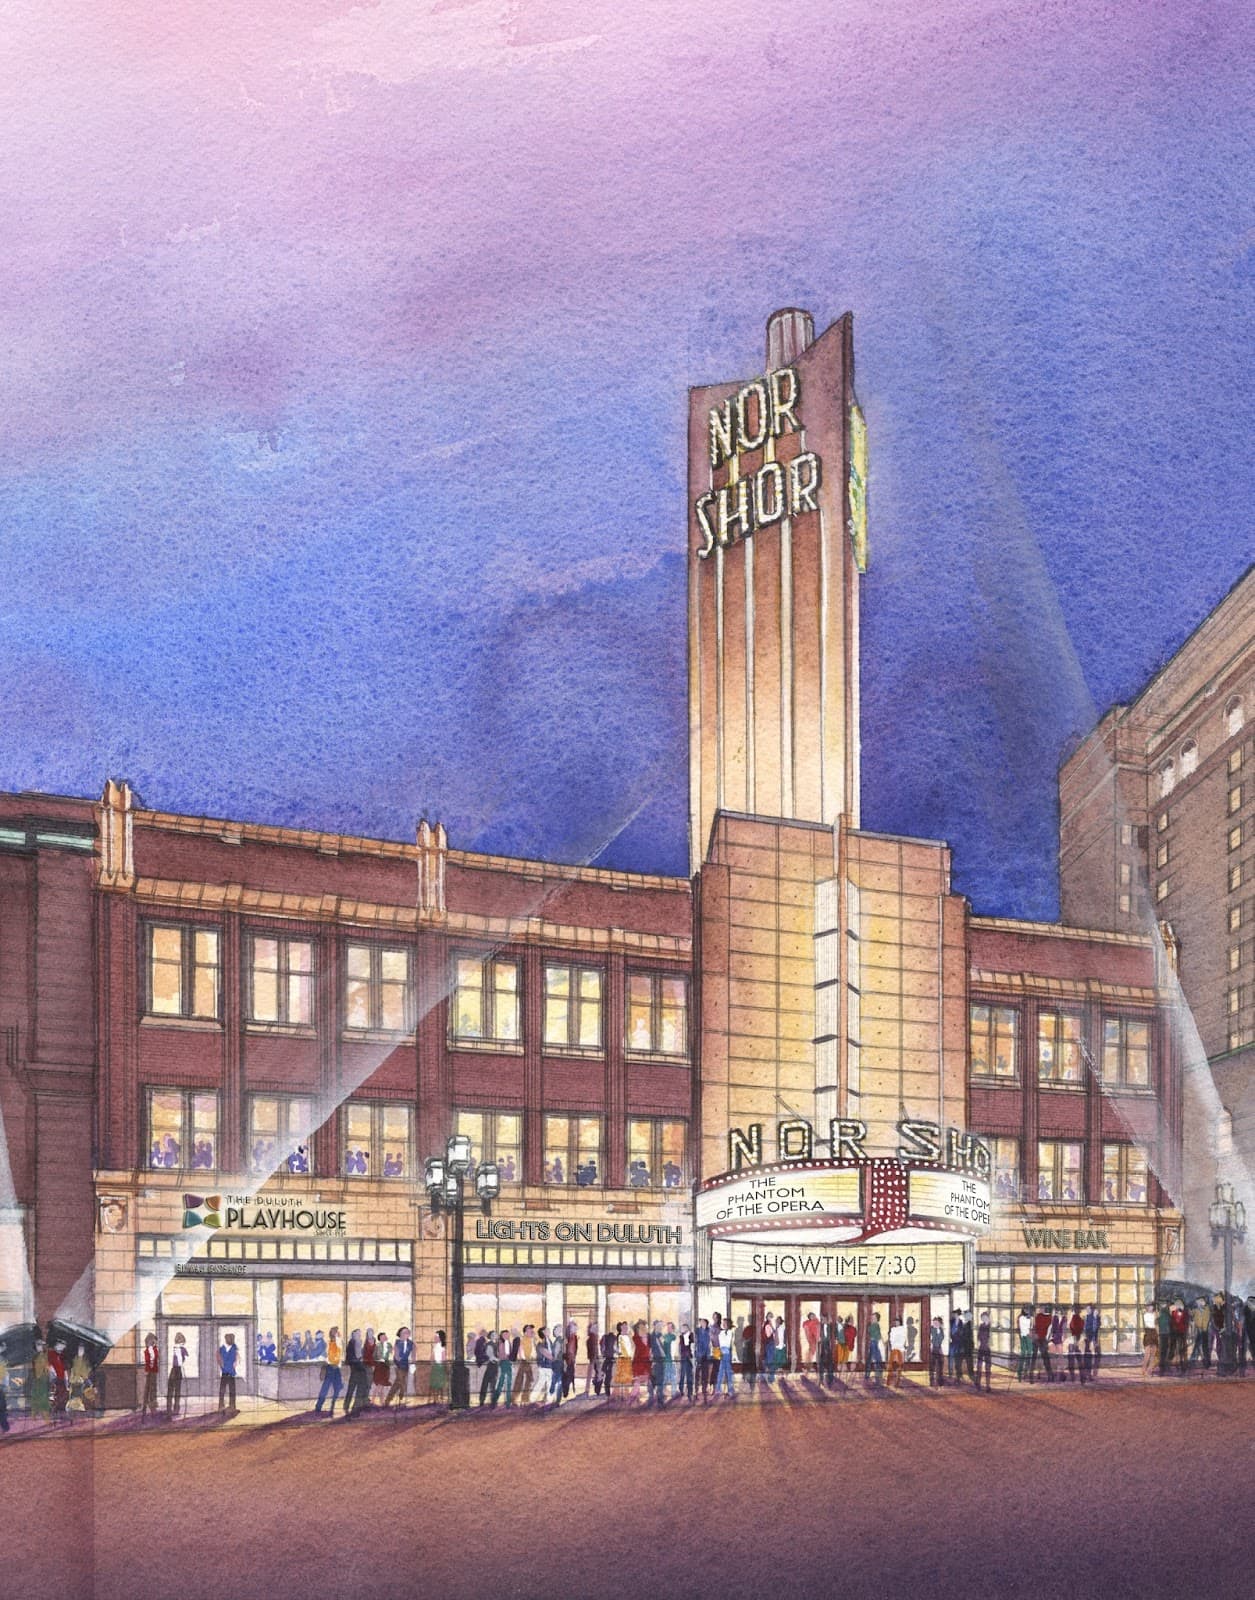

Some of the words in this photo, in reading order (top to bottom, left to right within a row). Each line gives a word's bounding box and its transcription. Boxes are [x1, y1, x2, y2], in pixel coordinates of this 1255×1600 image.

[710, 367, 805, 470] NOR
[696, 452, 821, 559] SHOR
[729, 1118, 868, 1171] NOR
[749, 1177, 776, 1189] THE
[962, 1180, 977, 1194] THE
[226, 1194, 251, 1205] THE
[256, 1196, 303, 1207] DULUTH
[728, 1187, 805, 1206] PHANTOM
[225, 1207, 347, 1230] PLAYHOUSE
[716, 1208, 733, 1220] OF
[736, 1203, 763, 1217] THE
[767, 1200, 825, 1213] OPERA
[944, 1204, 955, 1216] OF
[955, 1206, 969, 1219] THE
[476, 1220, 551, 1242] LIGHTS
[554, 1222, 594, 1242] ON
[597, 1223, 683, 1245] DULUTH
[1022, 1227, 1074, 1250] WINE
[1074, 1229, 1111, 1250] BAR
[752, 1254, 868, 1276] SHOWTIME
[875, 1255, 917, 1275] 7:30
